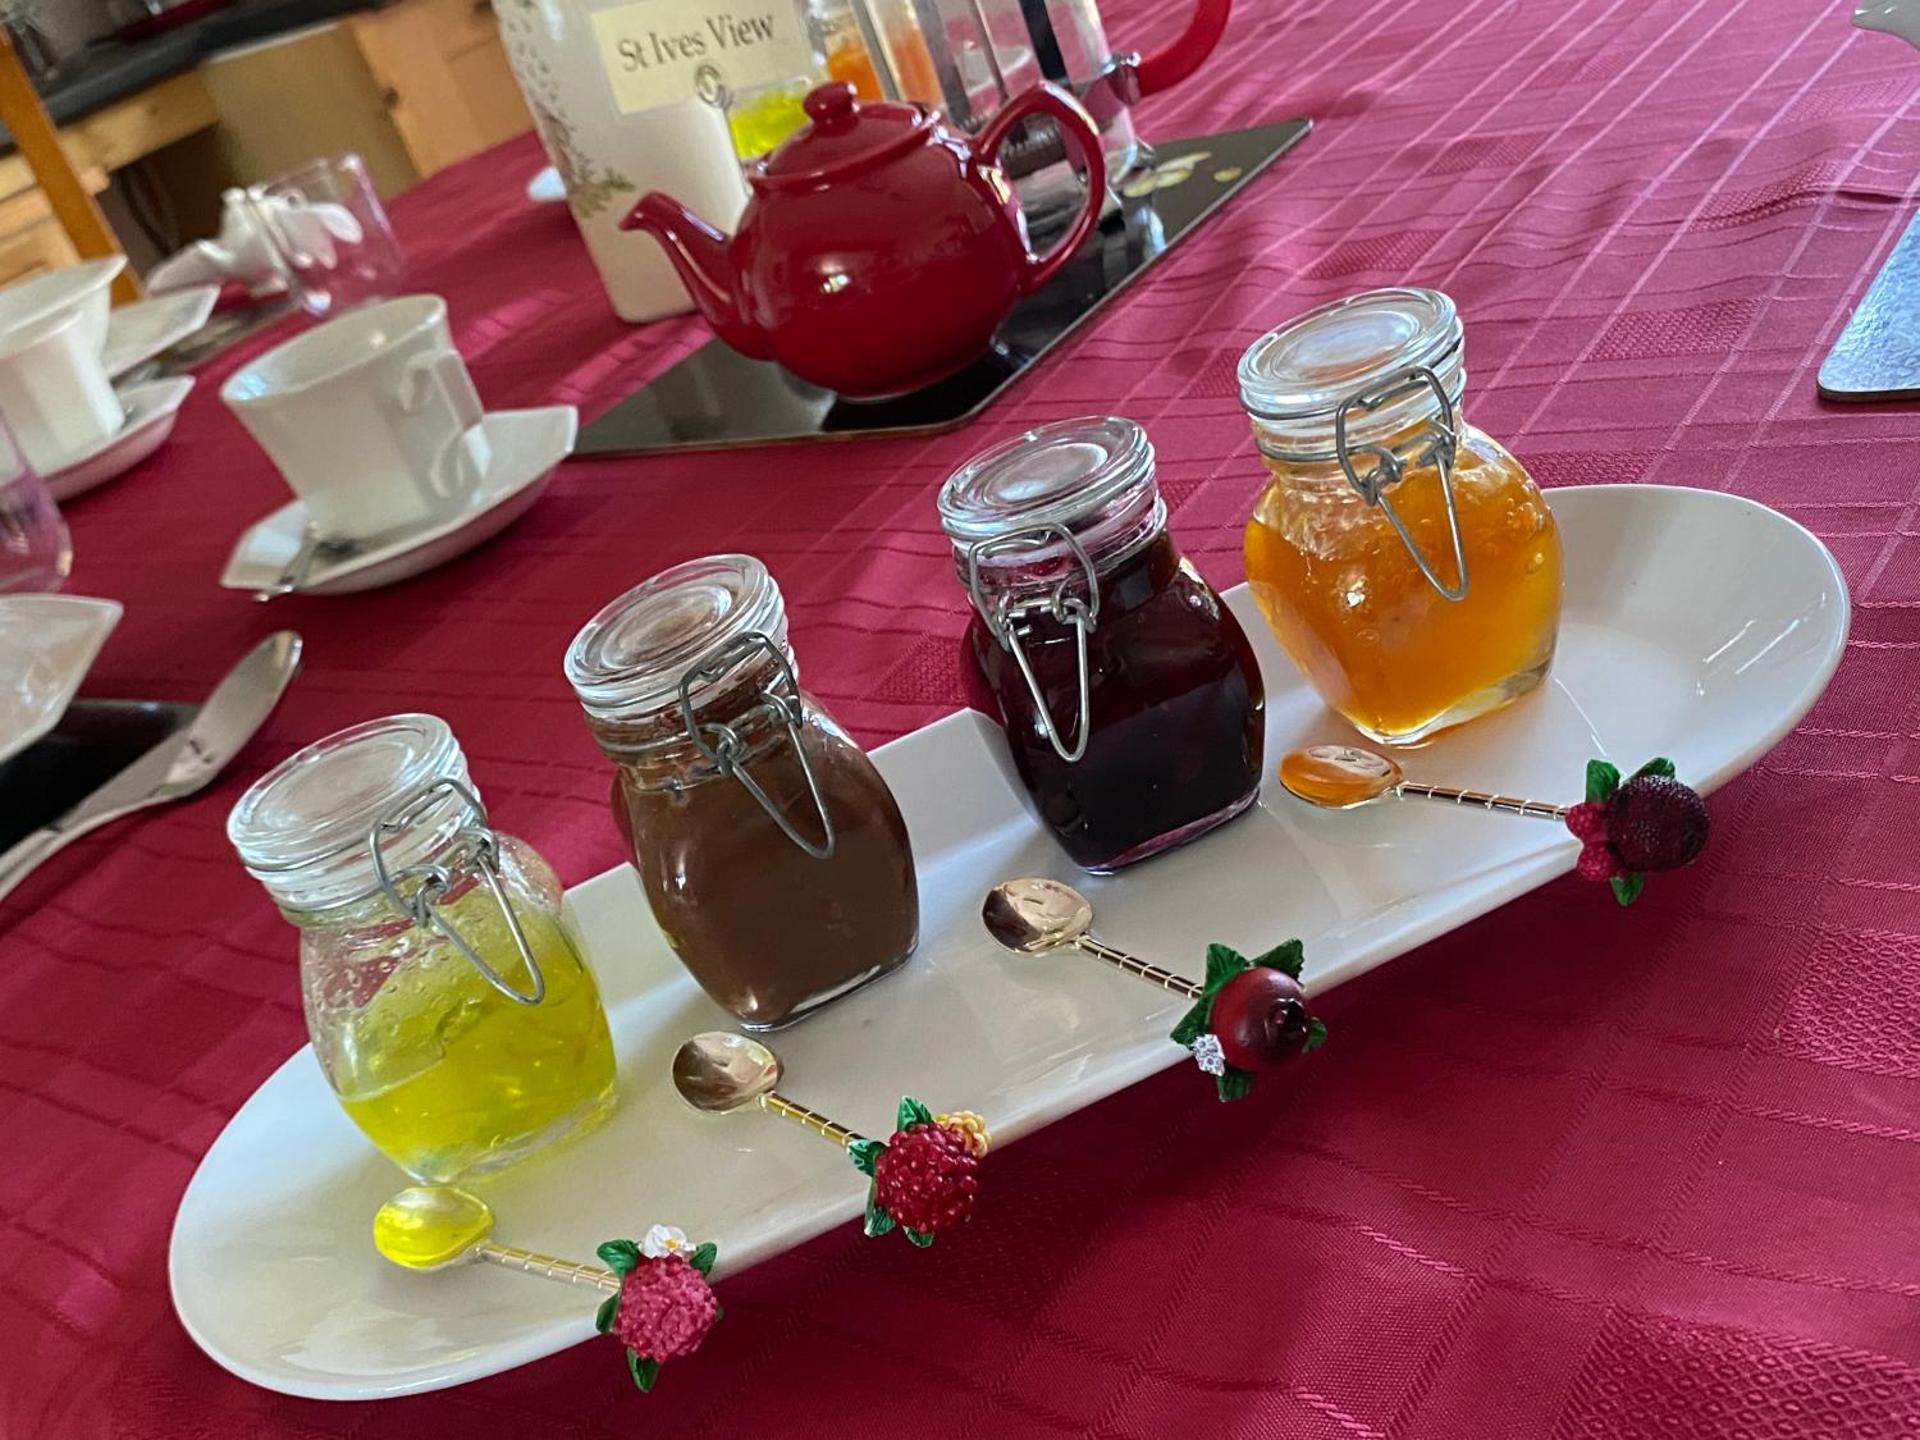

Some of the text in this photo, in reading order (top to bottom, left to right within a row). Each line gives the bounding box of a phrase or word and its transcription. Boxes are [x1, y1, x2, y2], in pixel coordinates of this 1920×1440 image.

[618, 13, 774, 72] St Ives View
